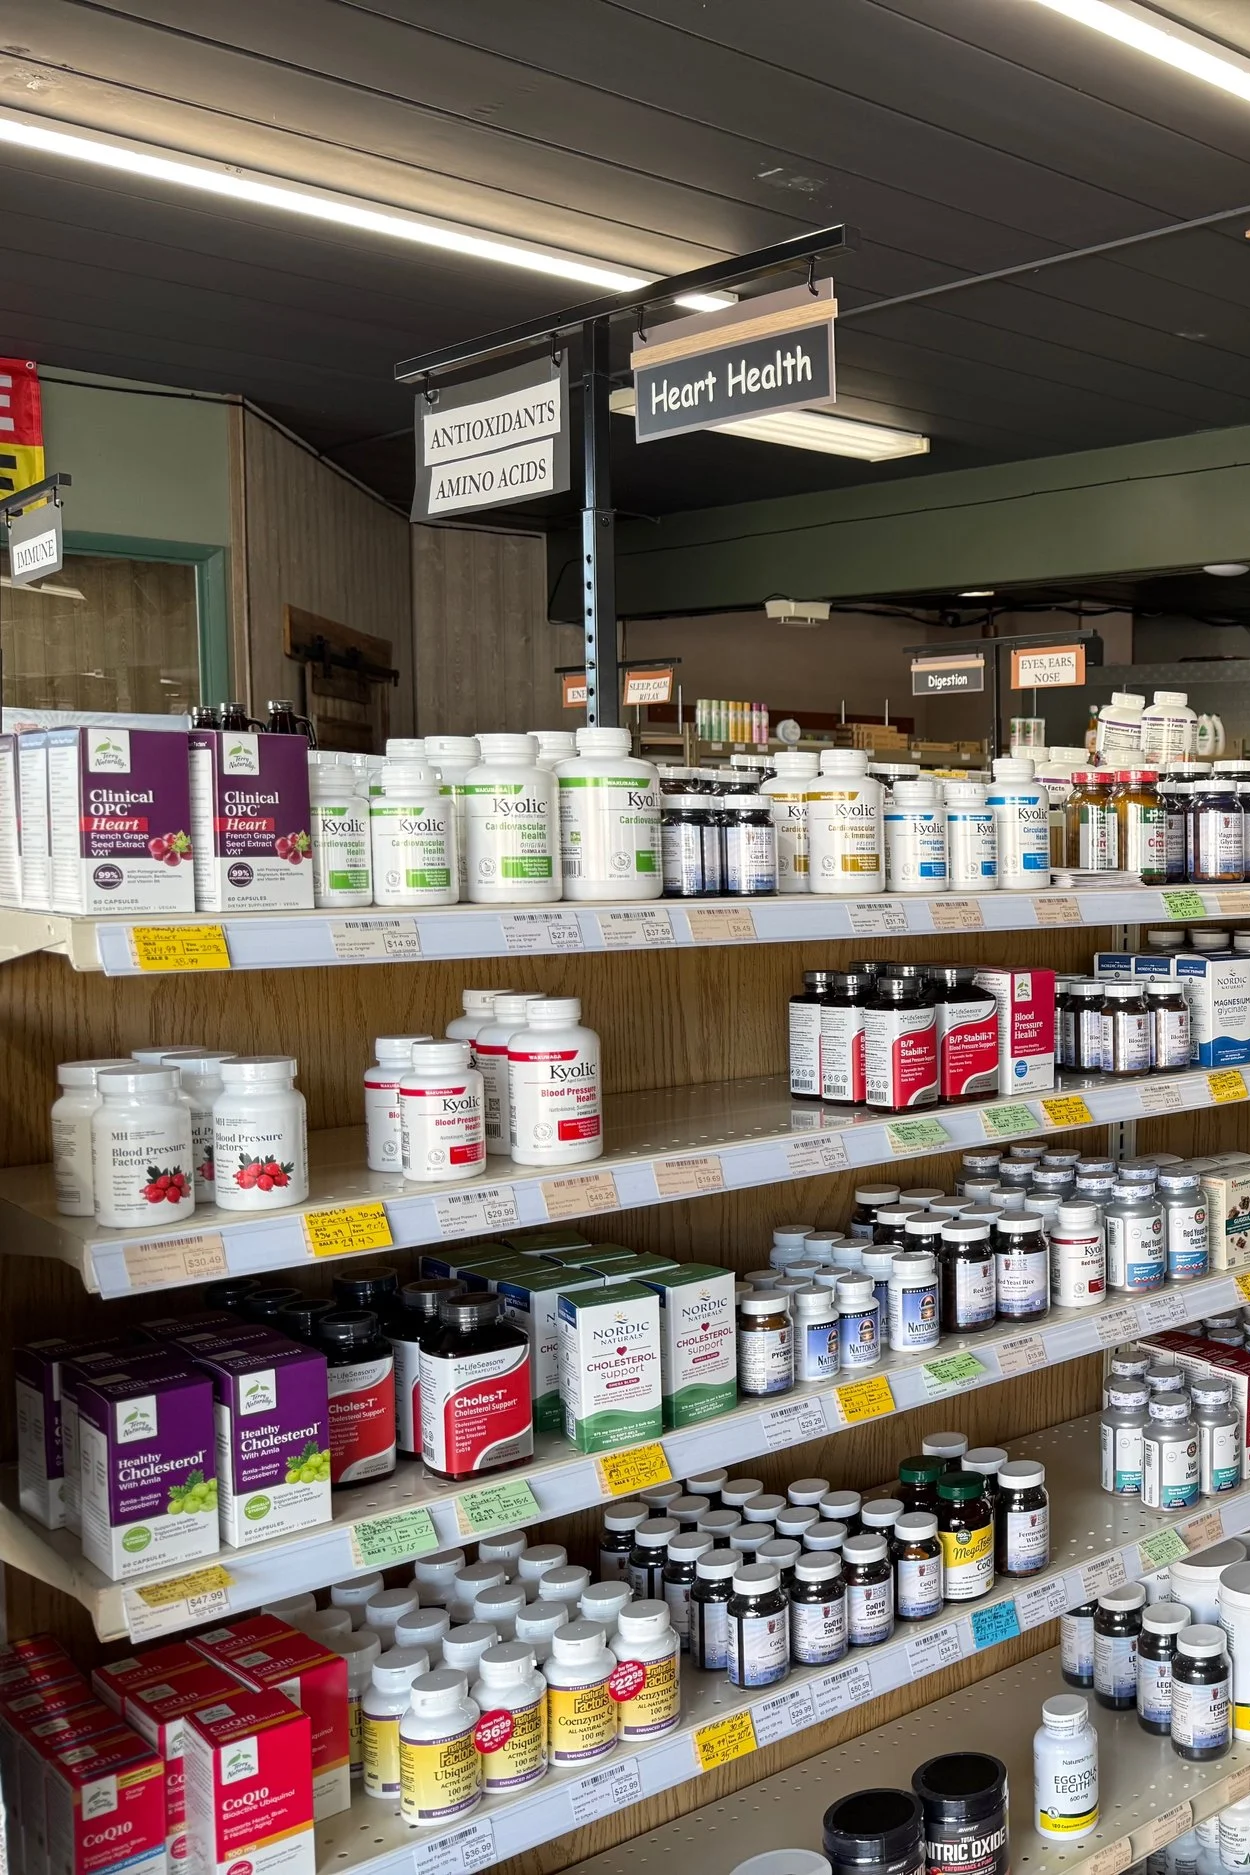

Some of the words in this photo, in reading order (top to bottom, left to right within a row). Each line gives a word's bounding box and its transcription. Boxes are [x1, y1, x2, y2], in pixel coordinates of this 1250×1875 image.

[651, 371, 717, 416] Heart
[727, 345, 812, 397] Health
[430, 400, 555, 449] ANTIOXIDANTS
[436, 469, 494, 500] AMINO
[498, 459, 547, 488] ACIDS
[16, 539, 55, 569] IMMUNE
[1021, 658, 1047, 670] EYES,
[1049, 657, 1074, 667] EARS,
[928, 674, 967, 689] Digestion
[1034, 672, 1060, 683] NOSE
[90, 790, 154, 803] Clinical
[224, 791, 279, 804] Clinical
[90, 804, 129, 816] OPC
[225, 804, 258, 816] OPC
[493, 798, 545, 817] Kyolic
[834, 804, 875, 820] Kyolic
[93, 818, 139, 830] Heart
[227, 818, 267, 830] Heart
[322, 819, 365, 835] Kyolic
[399, 819, 444, 835] Kyolic
[123, 833, 149, 841] Grape
[552, 931, 578, 939] $27.89
[387, 940, 417, 948] $14.99
[1217, 975, 1247, 987] NORDIC
[1214, 997, 1250, 1007] MAGNESIUM
[1015, 1013, 1034, 1021] Blood
[1217, 1004, 1247, 1016] glycinate
[1015, 1021, 1043, 1030] Pressure
[950, 1036, 962, 1044] B/P
[964, 1032, 993, 1041] Stabili-T
[1015, 1030, 1037, 1039] Health
[901, 1046, 927, 1056] Stabili-T
[550, 1063, 596, 1082] Kyolic
[541, 1088, 563, 1097] Blood
[565, 1086, 596, 1095] Pressure
[112, 1132, 128, 1141] MH
[112, 1148, 142, 1157] Blood
[146, 1142, 186, 1156] Pressure
[823, 1152, 845, 1161] $20.79
[112, 1156, 152, 1166] Factors
[487, 1207, 515, 1219] $29.99
[188, 1256, 222, 1268] $30.49
[682, 1298, 727, 1317] NORDIC
[688, 1309, 722, 1322] NATURALS
[593, 1322, 650, 1341] NORDIC
[601, 1332, 643, 1345] NATURALS
[676, 1327, 733, 1349] CHOLESTEROL
[688, 1339, 723, 1356] support
[464, 1358, 504, 1371] LifeSeasons
[587, 1352, 657, 1372] CHOLESTEROL
[336, 1368, 376, 1380] LifeSeasons
[601, 1364, 645, 1380] support
[329, 1398, 375, 1414] Choles-T
[455, 1390, 503, 1409] Choles-T
[362, 1407, 385, 1419] Support
[455, 1404, 490, 1418] Cholesterol
[492, 1399, 516, 1412] Support
[800, 1417, 824, 1431] $29.29
[241, 1424, 280, 1440] Healthy
[241, 1424, 318, 1452] Cholesterol
[241, 1450, 258, 1460] With
[259, 1446, 280, 1457] Amla
[118, 1453, 161, 1469] Healthy
[118, 1452, 204, 1483] Cholesterol
[242, 1469, 278, 1482] Gooseberry
[118, 1479, 137, 1491] With
[139, 1475, 161, 1487] Amla
[120, 1499, 159, 1513] Gooseberry
[865, 1600, 886, 1612] CoQ10
[581, 1686, 605, 1700] natural
[851, 1682, 870, 1694] $50.59
[574, 1694, 609, 1714] Factors
[792, 1705, 812, 1719] $29.99
[558, 1713, 606, 1726] Coenzyme
[568, 1724, 601, 1734] ALL-NATURAL
[440, 1744, 476, 1768] Factors
[508, 1750, 527, 1759] ACTIVE
[567, 1750, 591, 1759] ENHANCED
[1054, 1774, 1073, 1785] EGG
[1074, 1766, 1098, 1781] YOLK
[441, 1779, 460, 1789] ACTIVE
[615, 1781, 638, 1795] $22.99
[222, 1787, 269, 1812] CoQ10
[222, 1800, 258, 1820] Bioactive
[260, 1789, 295, 1809] Ubiquinol
[83, 1822, 133, 1848] CoQ10
[464, 1842, 492, 1859] $36.99
[926, 1841, 968, 1861] NITRIC
[972, 1826, 1006, 1859] OXIDE
